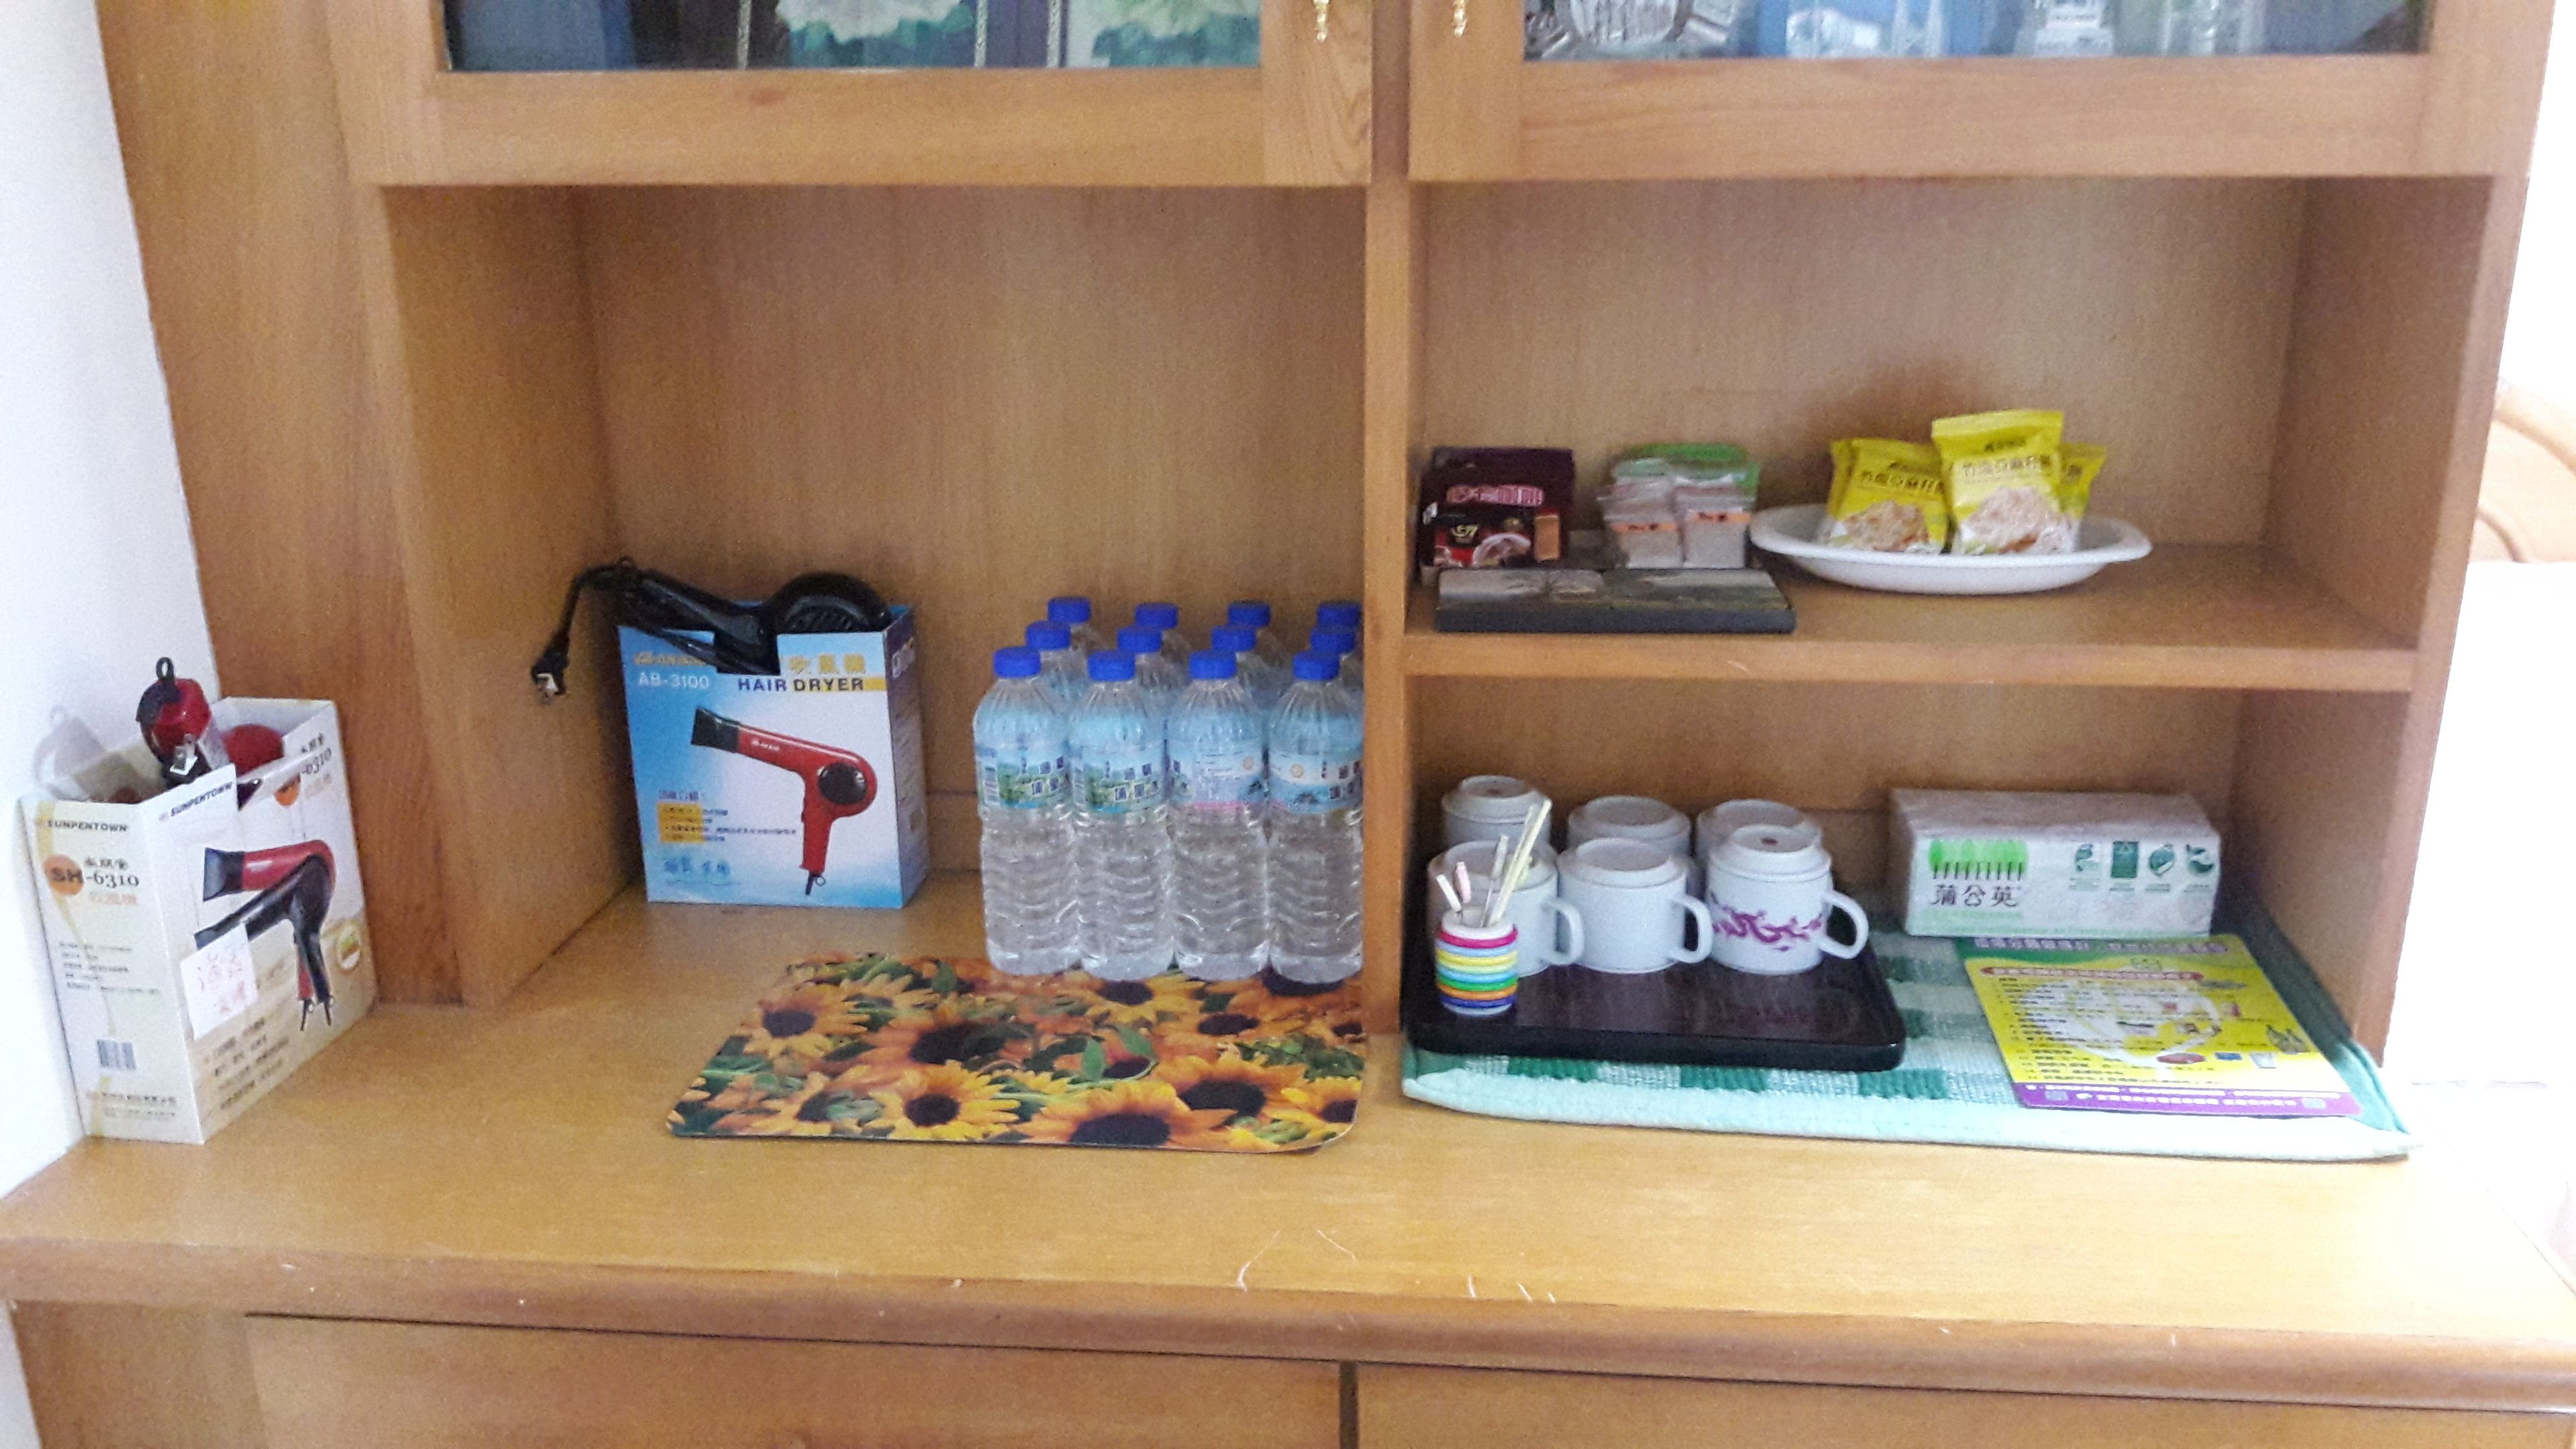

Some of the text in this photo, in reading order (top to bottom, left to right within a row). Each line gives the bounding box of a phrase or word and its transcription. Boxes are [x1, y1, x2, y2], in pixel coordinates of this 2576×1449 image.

[638, 672, 710, 689] AB-3100
[737, 677, 864, 693] HAIR DRYER
[170, 781, 233, 818] SUNPENTOWN
[47, 820, 129, 832] SUNPENTOWN
[50, 866, 140, 889] SH-6310
[1930, 883, 2019, 907] 蒲公英
